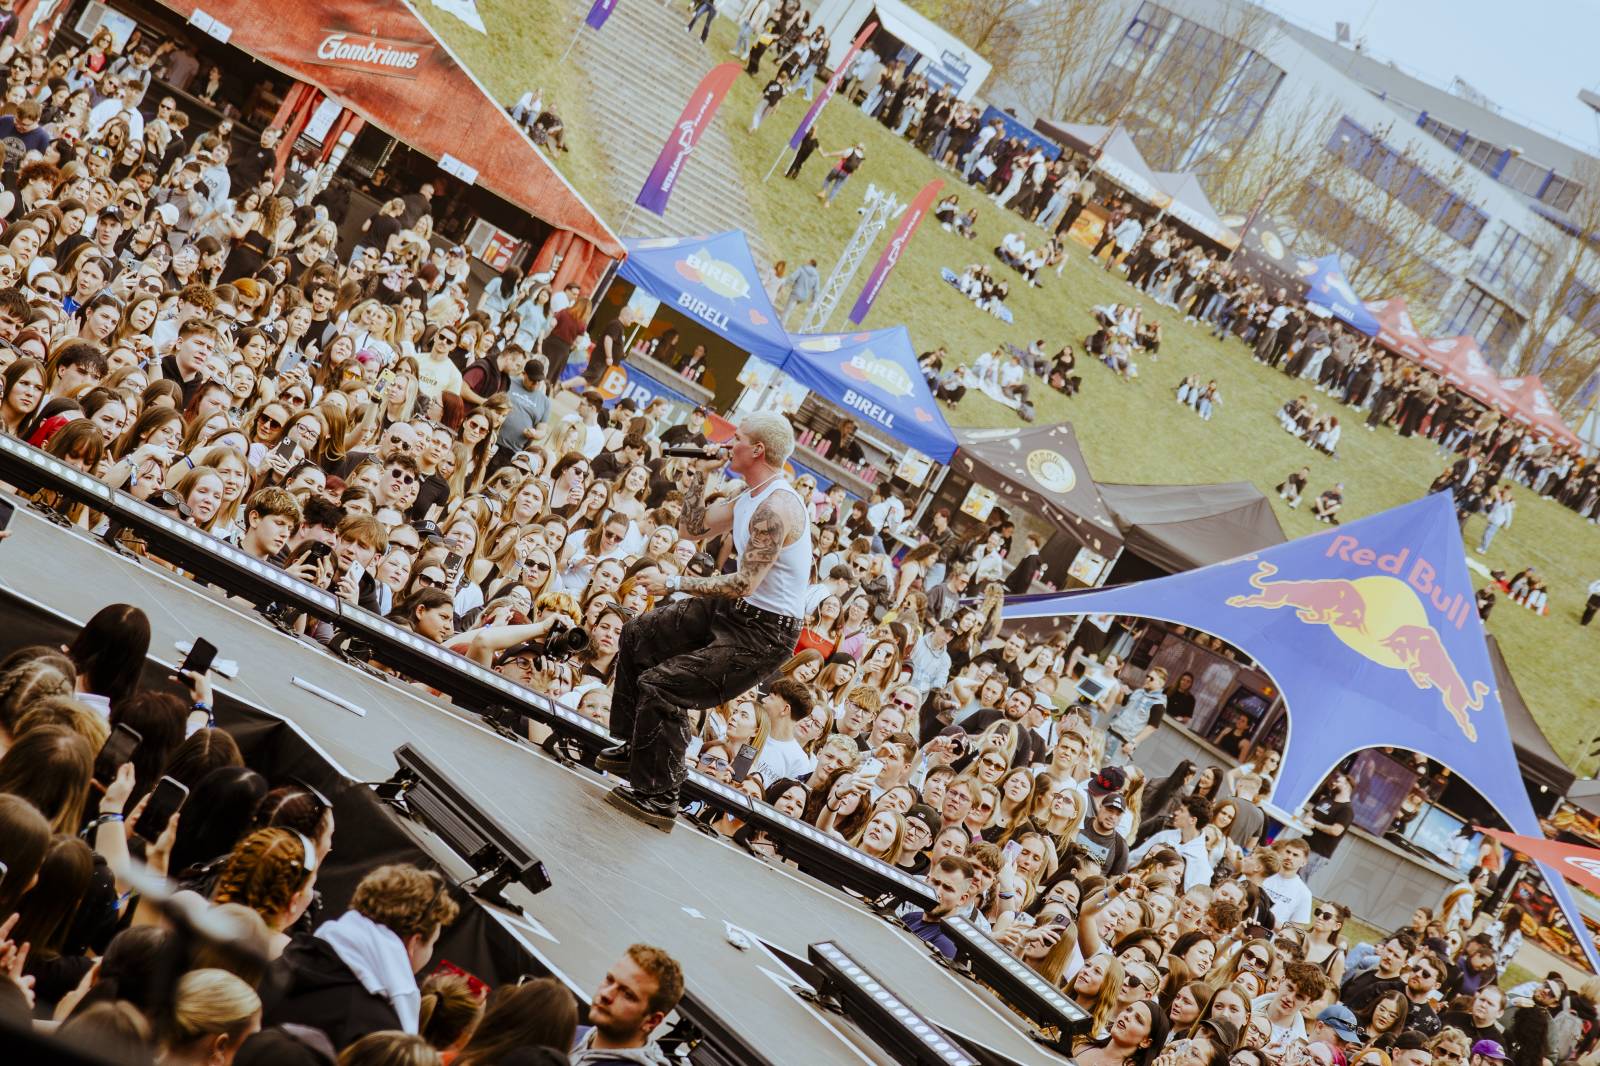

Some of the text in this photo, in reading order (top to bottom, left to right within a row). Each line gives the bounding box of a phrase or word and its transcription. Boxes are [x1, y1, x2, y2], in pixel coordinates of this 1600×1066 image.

[317, 33, 419, 69] Gambrinus
[678, 291, 729, 332] BIRELL
[842, 389, 895, 429] BIRELL
[1325, 535, 1471, 630] Red Bull
